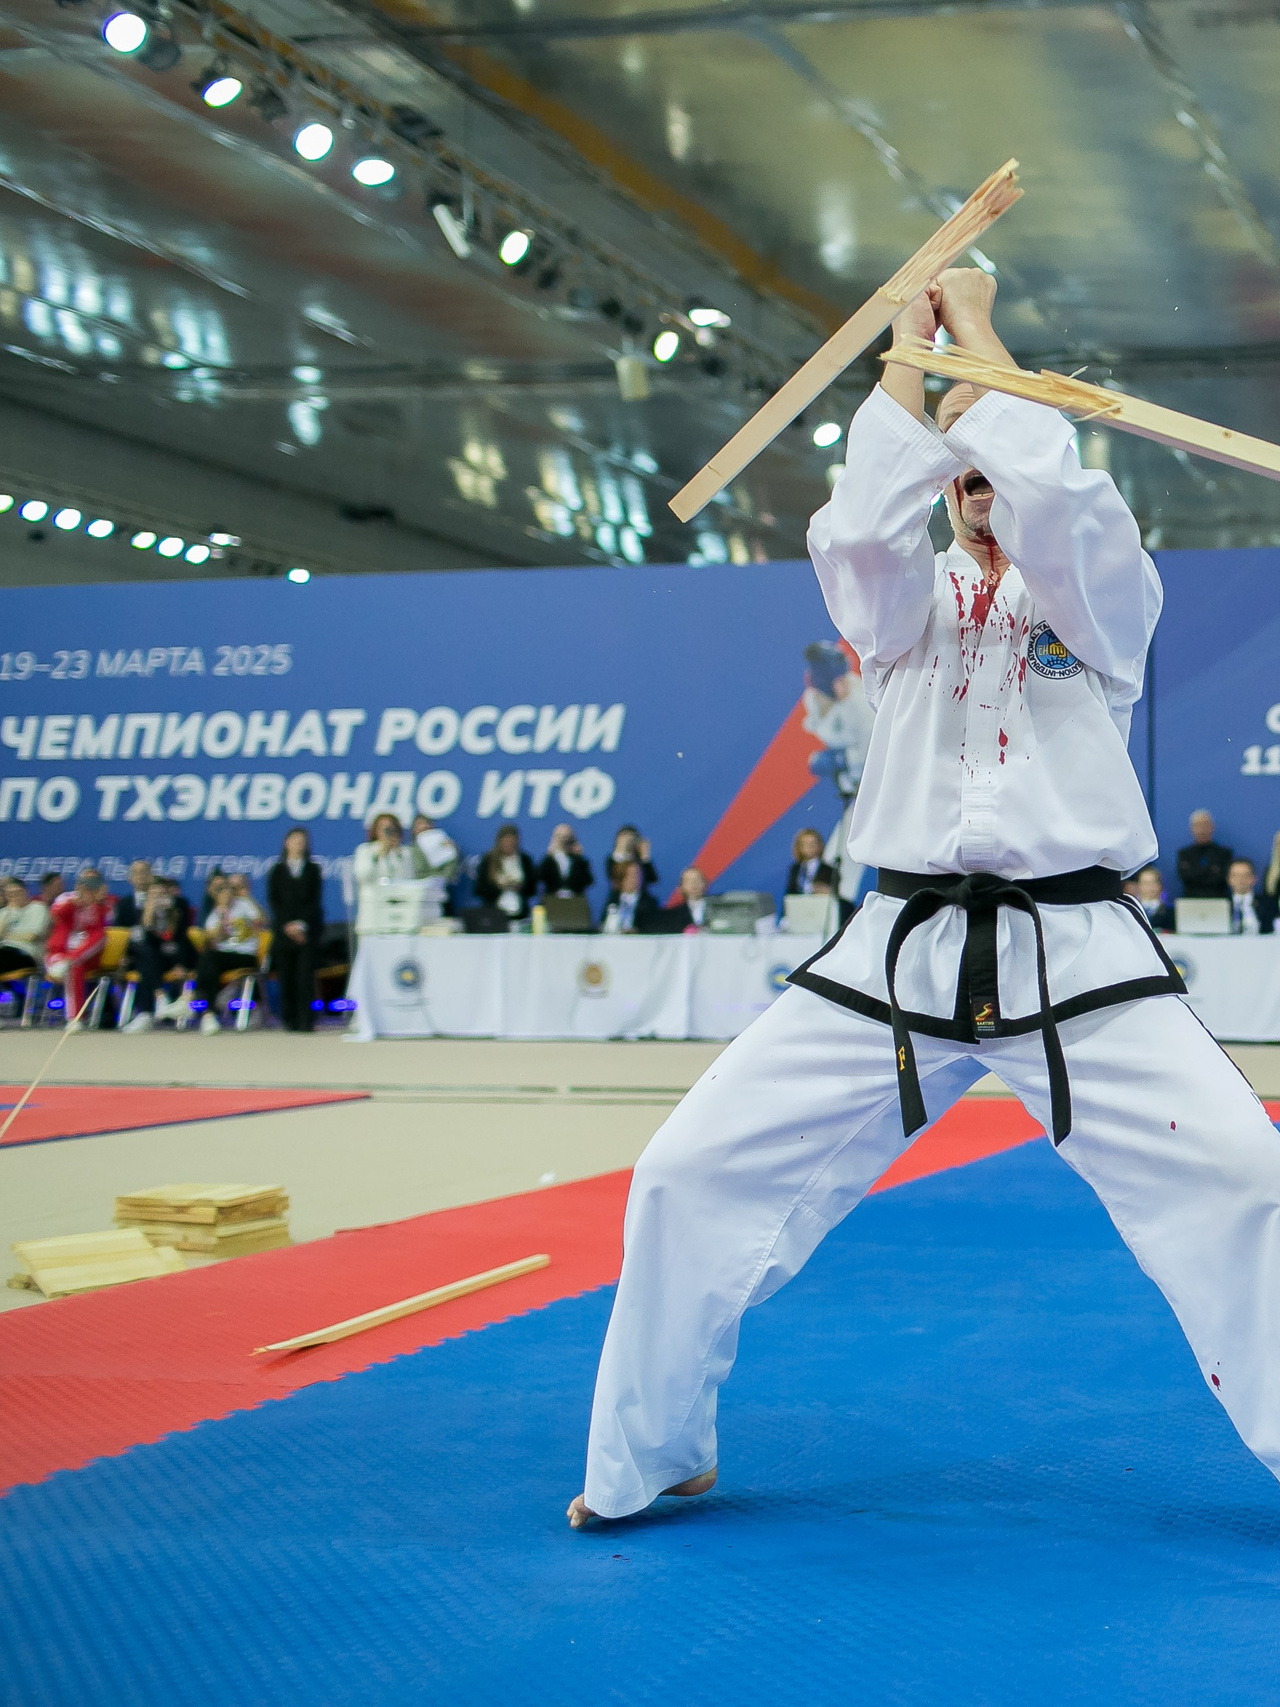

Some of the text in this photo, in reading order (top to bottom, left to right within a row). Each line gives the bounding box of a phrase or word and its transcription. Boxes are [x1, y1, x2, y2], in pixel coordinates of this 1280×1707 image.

[96, 646, 206, 677] МАРТА
[212, 644, 292, 677] 2025
[1, 702, 627, 760] ЧЕМПИОНАТ РОССИИ
[0, 765, 617, 829] ПО ТХЭКВОНДО ИТФ
